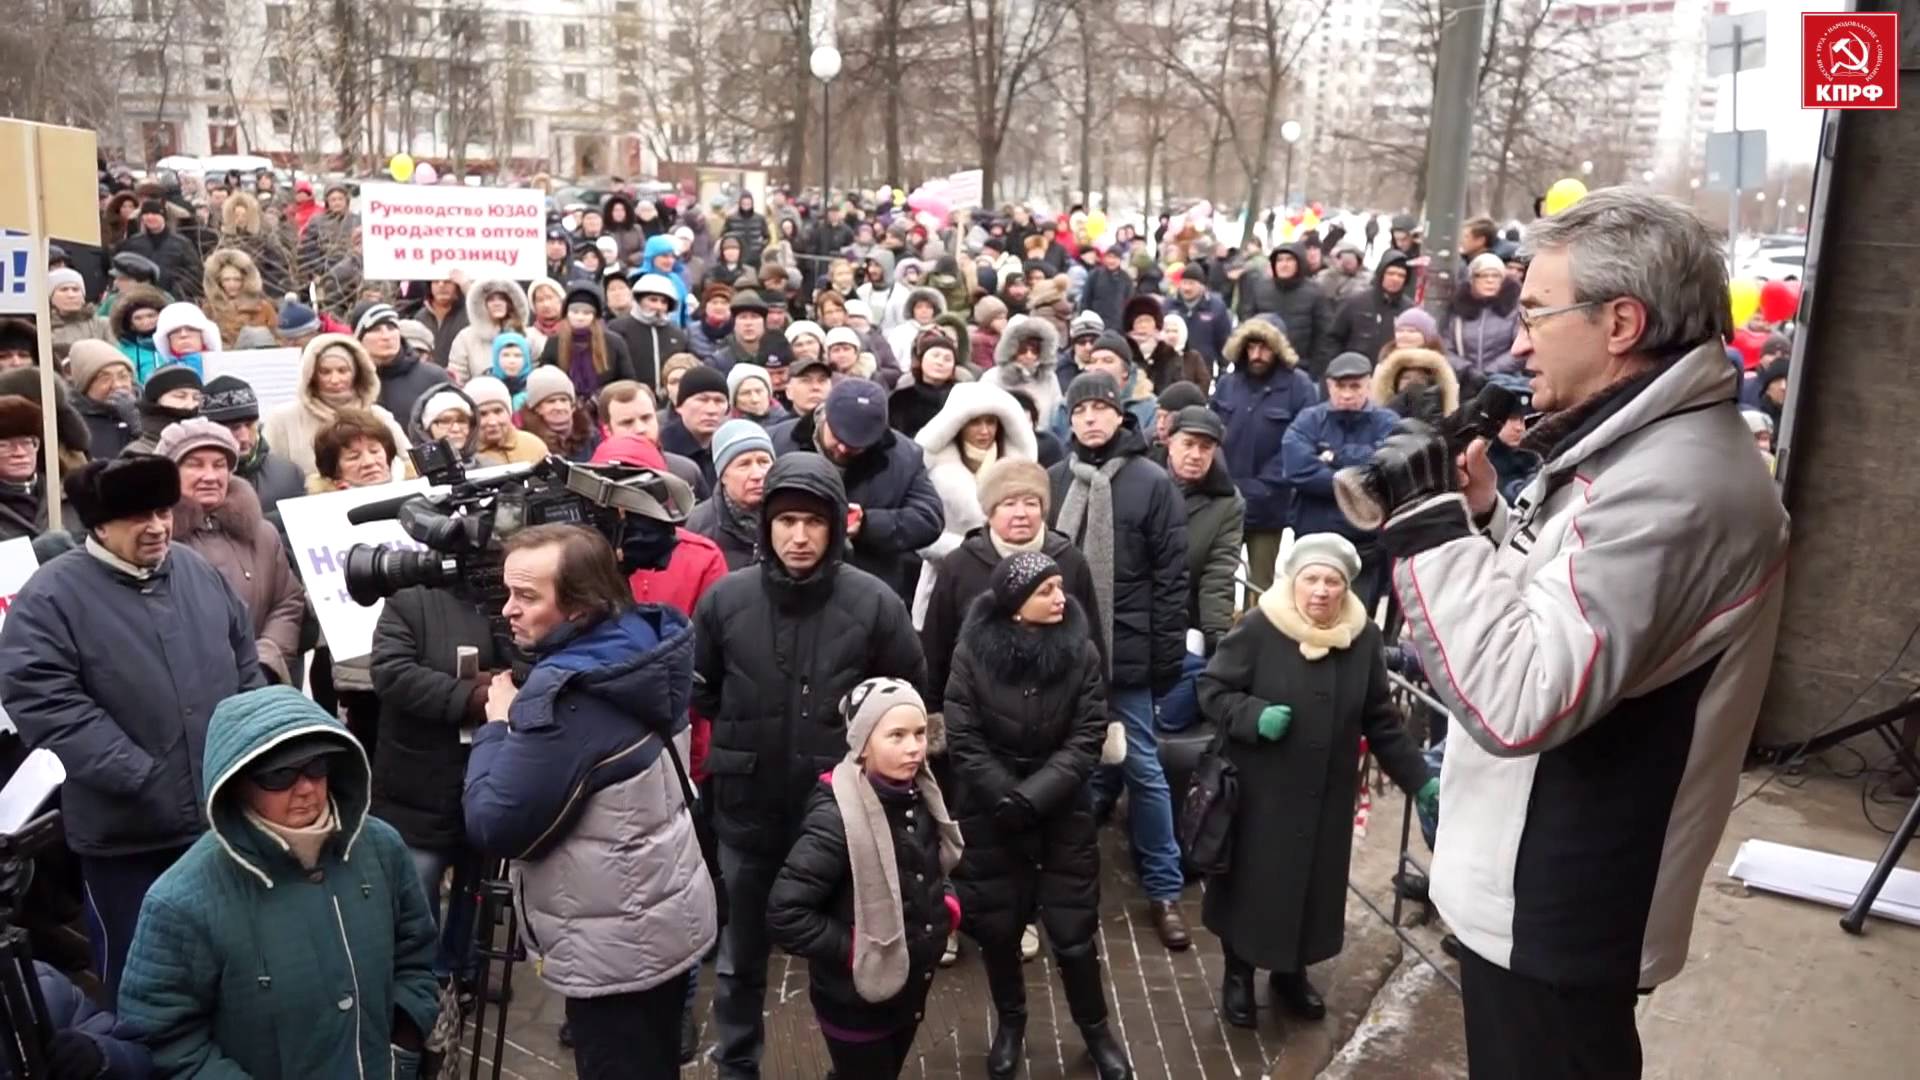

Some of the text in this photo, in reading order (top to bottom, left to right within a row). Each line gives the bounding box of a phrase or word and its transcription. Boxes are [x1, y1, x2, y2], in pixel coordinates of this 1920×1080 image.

[370, 200, 539, 218] Руководство ЮЗАО
[371, 223, 539, 240] продается оптом
[394, 248, 520, 266] и в розницу
